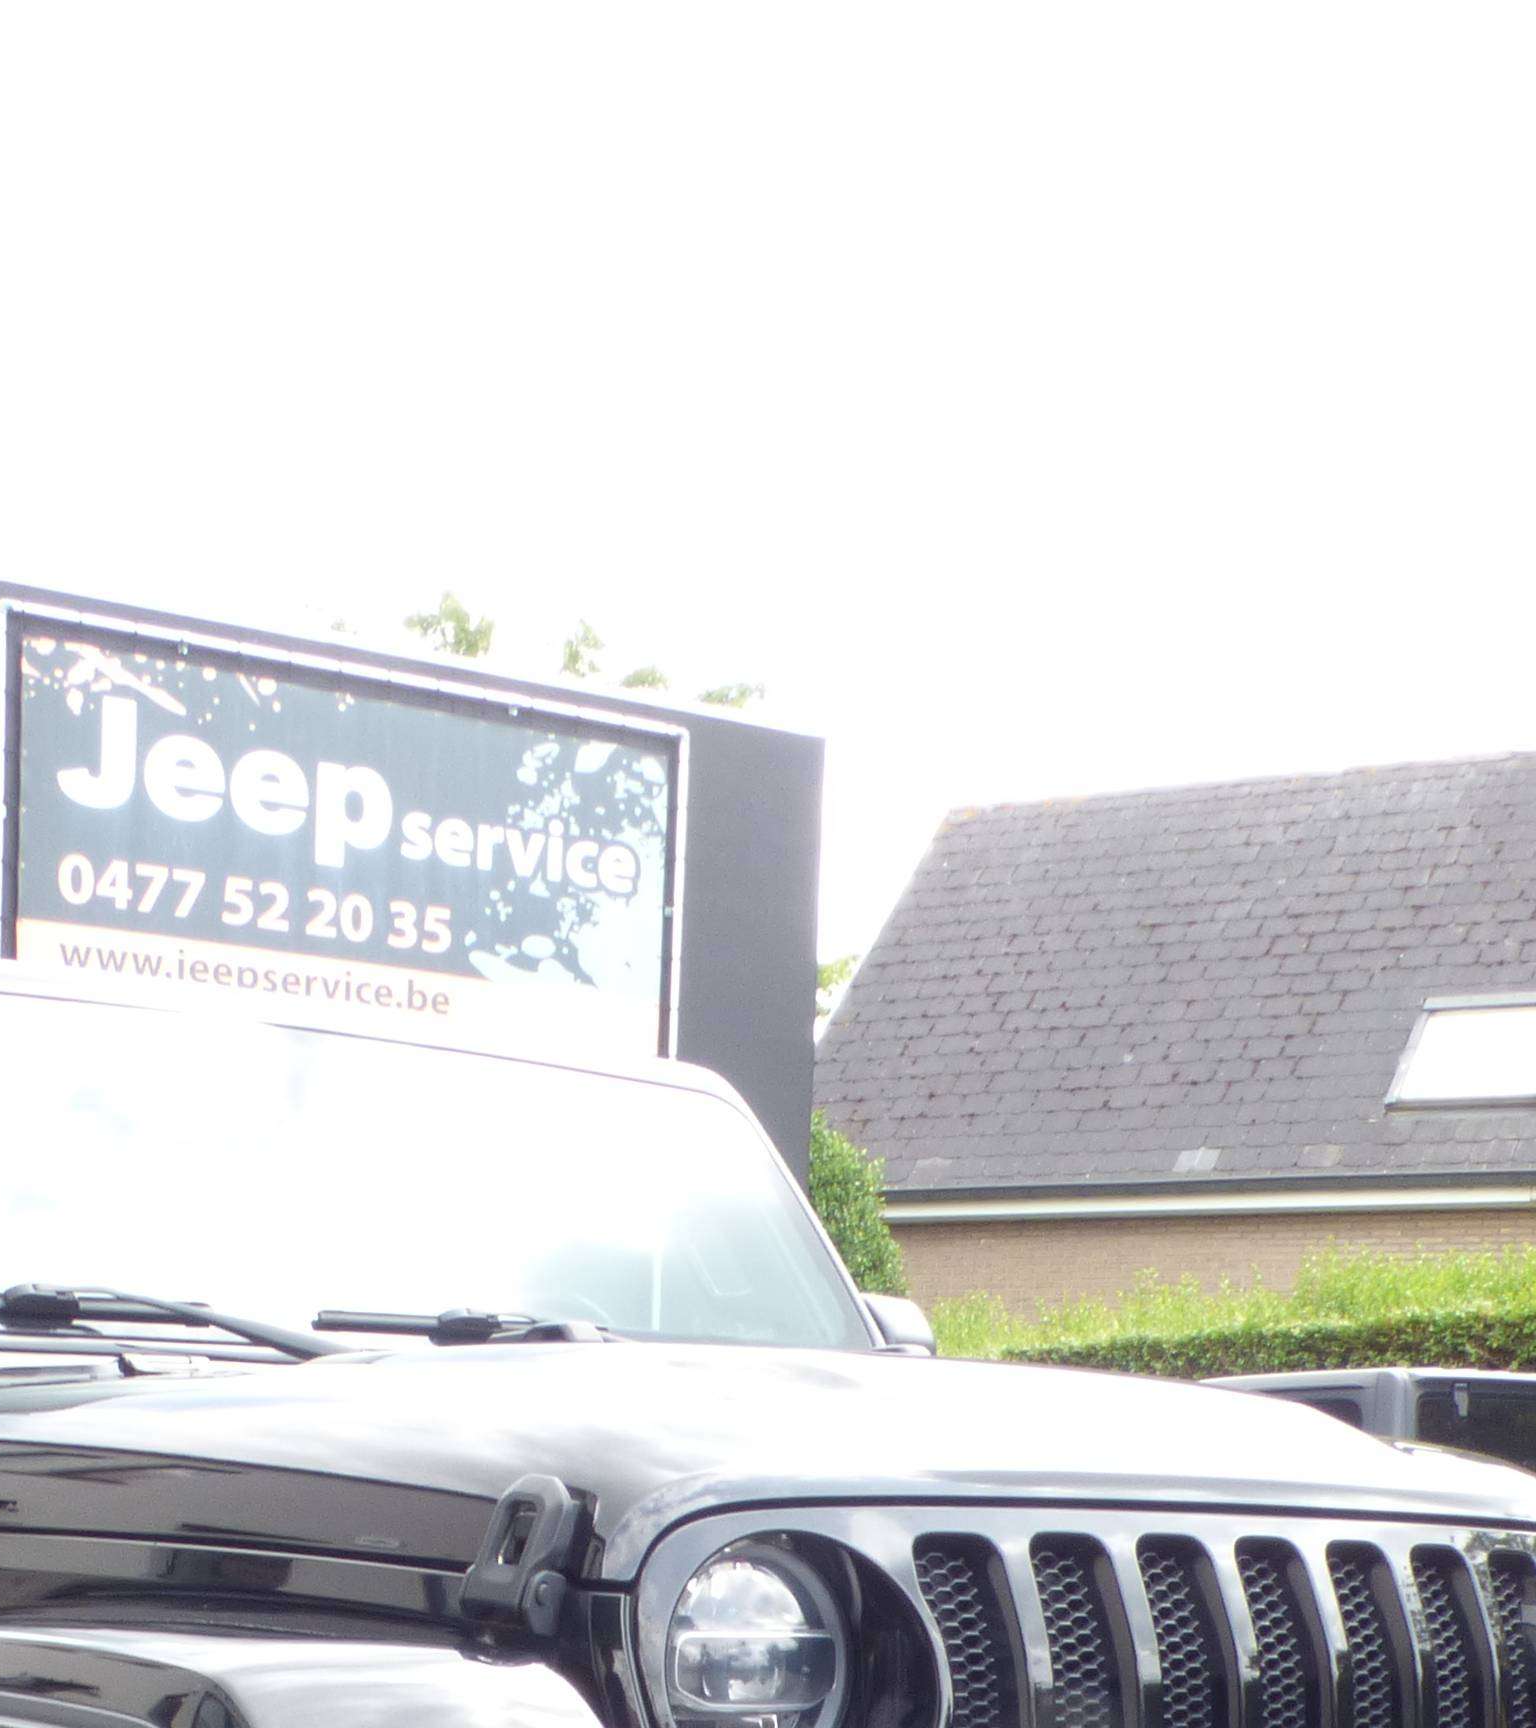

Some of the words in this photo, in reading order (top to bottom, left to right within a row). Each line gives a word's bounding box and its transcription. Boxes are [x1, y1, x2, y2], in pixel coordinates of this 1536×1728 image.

[56, 695, 394, 868] Jeep
[399, 808, 641, 895] service
[57, 852, 206, 918] 0477
[221, 876, 290, 933] 52
[305, 890, 374, 944] 20
[386, 899, 453, 954] 35
